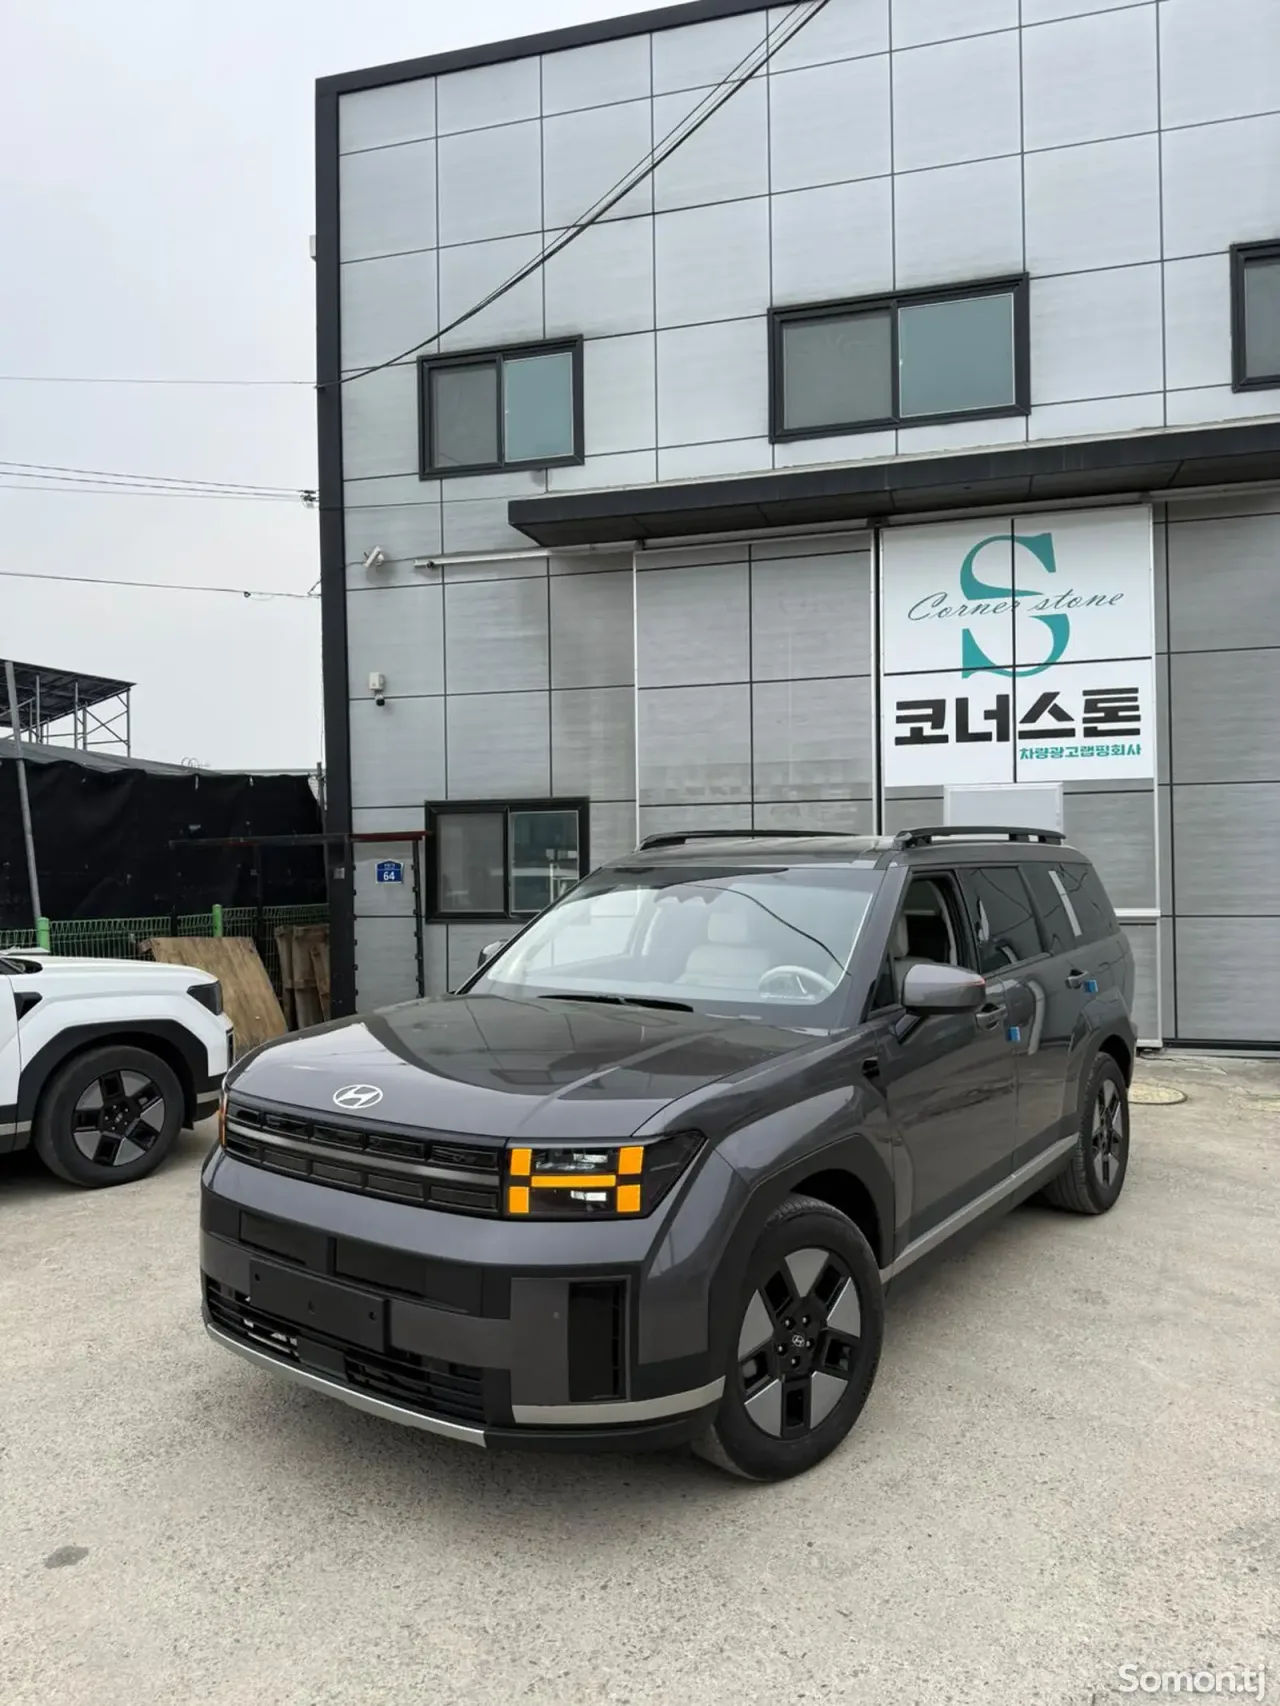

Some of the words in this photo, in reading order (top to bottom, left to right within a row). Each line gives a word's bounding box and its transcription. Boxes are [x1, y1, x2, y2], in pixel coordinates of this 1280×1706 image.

[908, 592, 1020, 620] Corner
[1029, 589, 1124, 612] stone
[895, 688, 1141, 745] 코너스톤
[1020, 744, 1141, 759] 차량광고랩핑회사
[383, 871, 395, 881] 64
